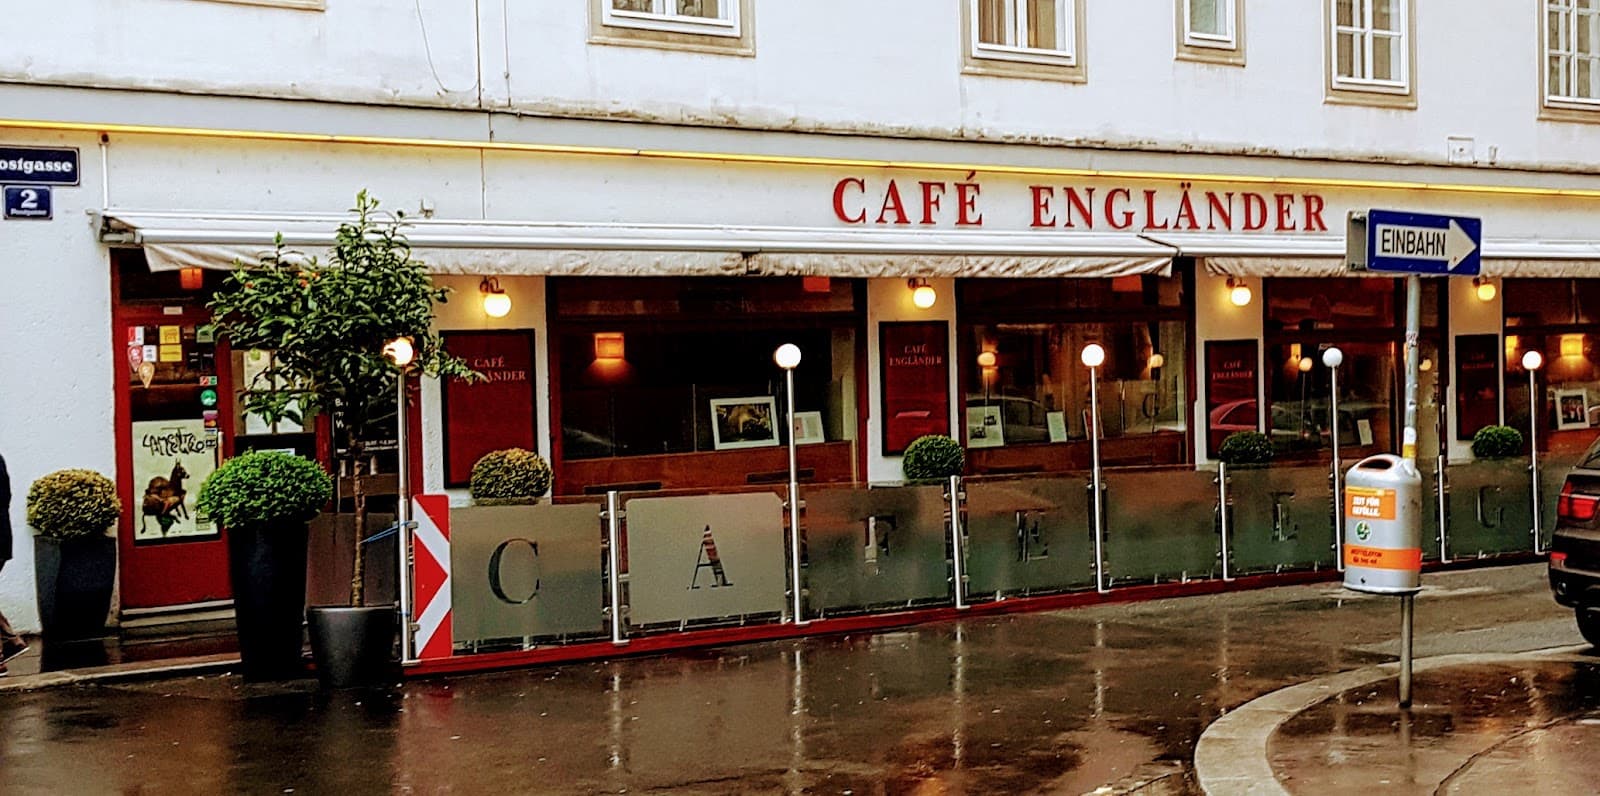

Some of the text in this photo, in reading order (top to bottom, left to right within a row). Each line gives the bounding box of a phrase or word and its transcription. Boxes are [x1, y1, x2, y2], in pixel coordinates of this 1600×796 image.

[0, 157, 73, 174] ostgasse
[20, 189, 38, 209] 2
[832, 170, 1328, 232] CAFÉ ENGLÄNDER
[1381, 228, 1446, 257] EINBAHN
[474, 355, 504, 368] CAFÉ
[488, 537, 540, 604] C
[686, 523, 734, 590] A
